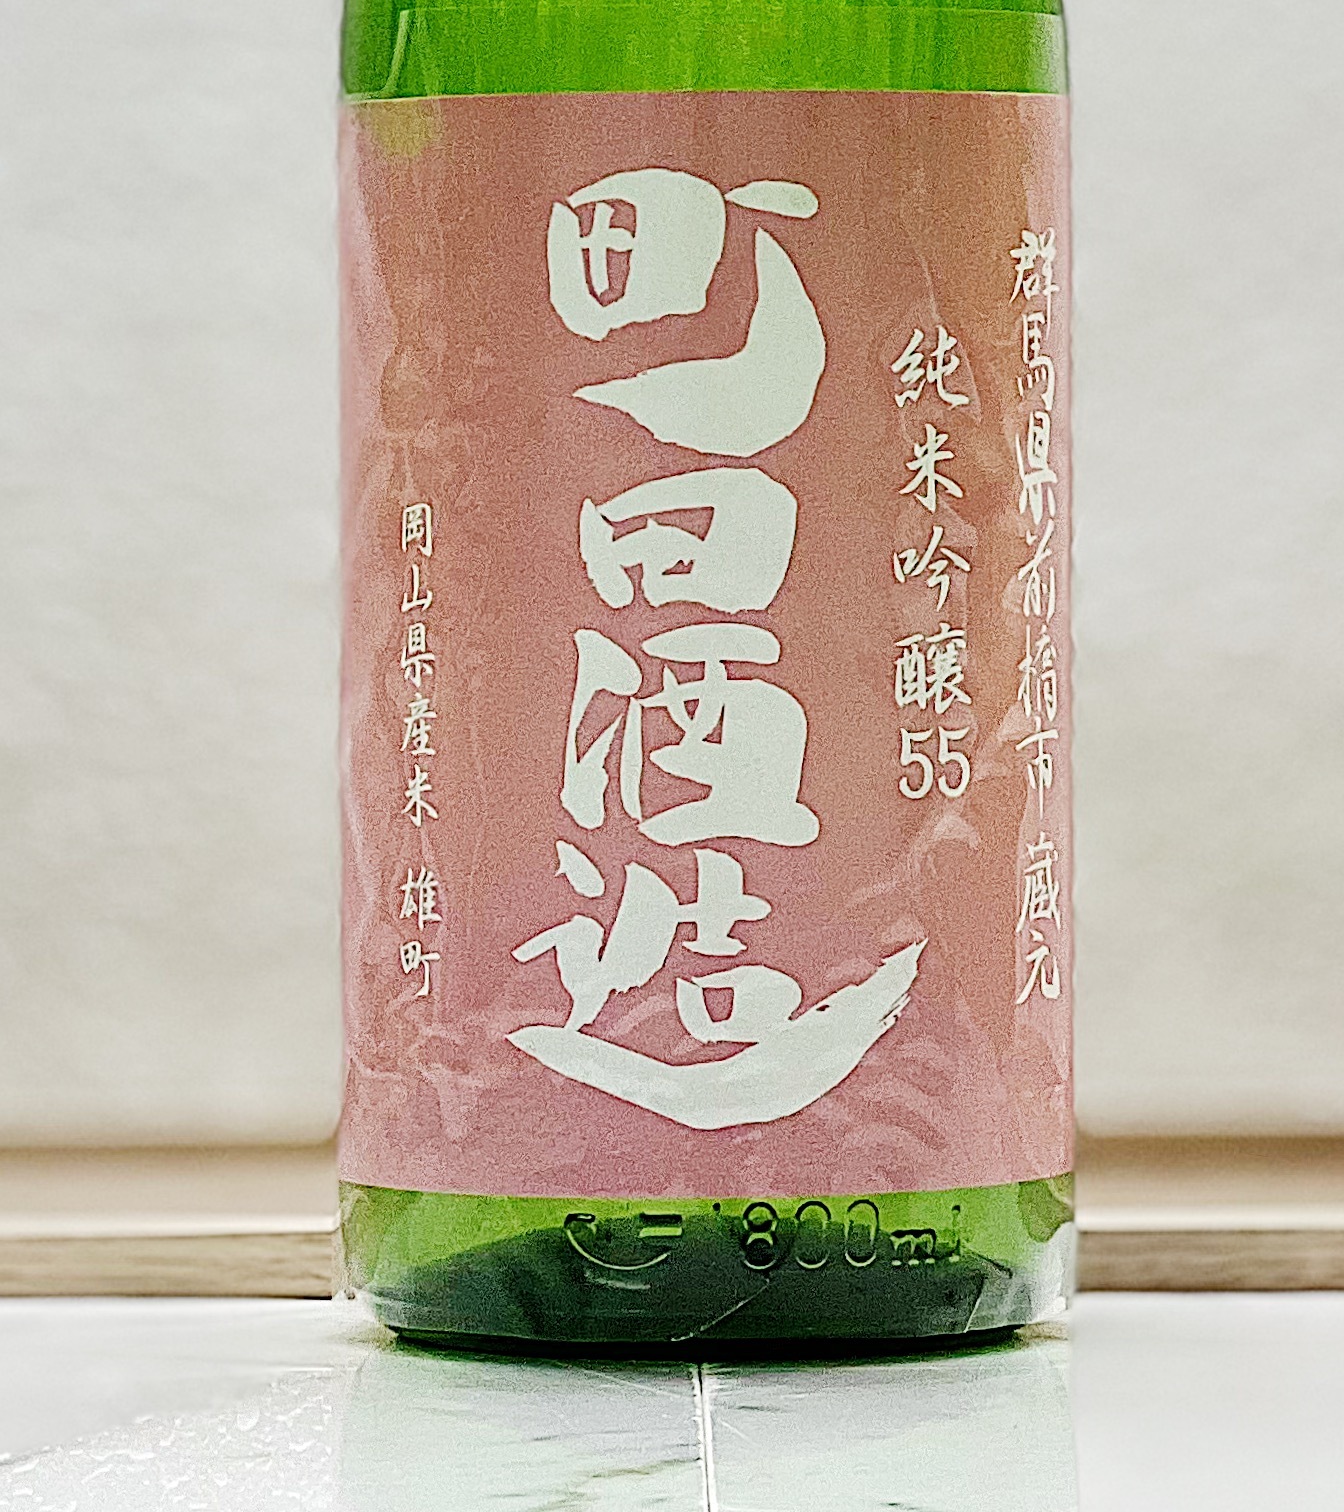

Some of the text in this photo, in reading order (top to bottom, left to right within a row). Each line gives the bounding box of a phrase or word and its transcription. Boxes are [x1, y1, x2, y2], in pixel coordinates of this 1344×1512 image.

[398, 502, 443, 997] 岡山県産米 雄町
[506, 167, 929, 1131] 町田酒造
[709, 1197, 962, 1271] 800ml
